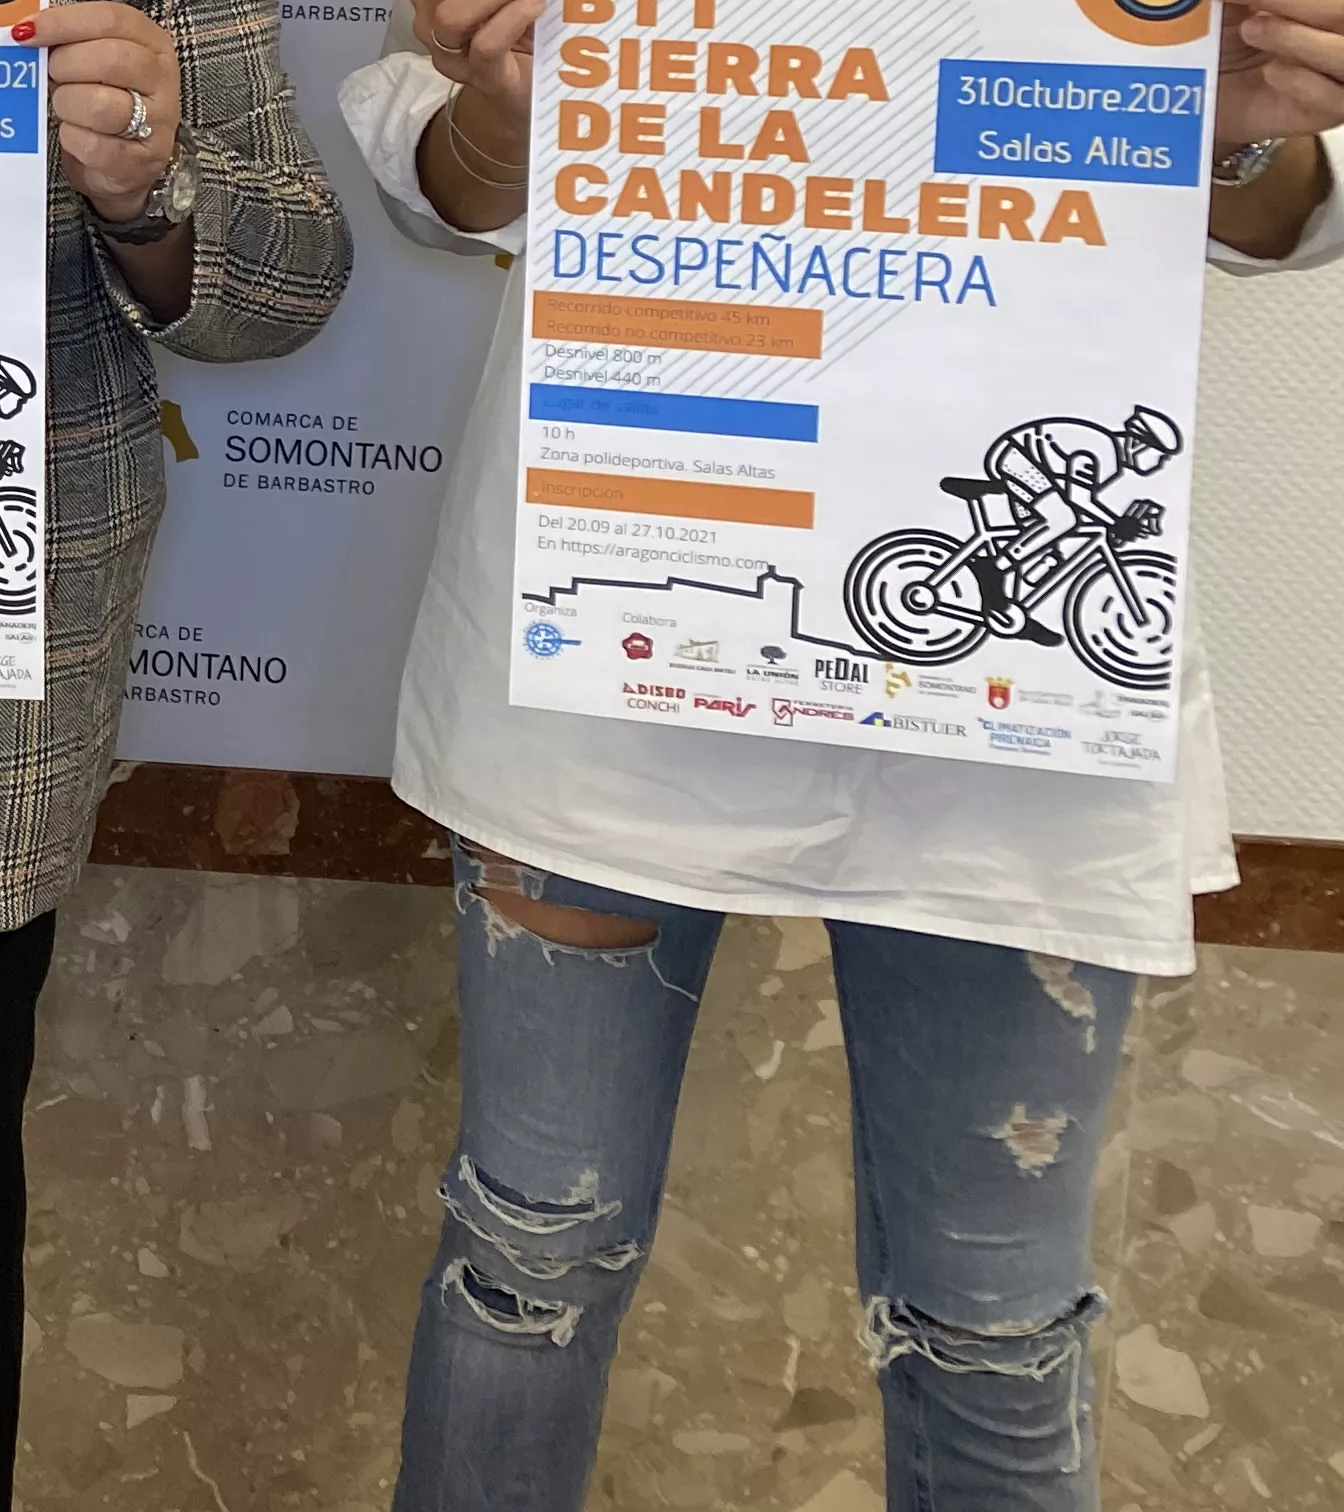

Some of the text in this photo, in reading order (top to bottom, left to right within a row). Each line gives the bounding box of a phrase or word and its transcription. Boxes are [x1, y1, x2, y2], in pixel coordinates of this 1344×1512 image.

[560, 37, 887, 101] SIERRA
[559, 101, 807, 162] DE LA
[979, 131, 1171, 168] Salas Altas
[555, 164, 1104, 245] CANDELERA
[553, 229, 995, 306] DESPEÑACERA
[228, 411, 357, 431] COMARCA DE
[225, 436, 442, 472] SOMONTANO
[224, 473, 374, 495] DE BARBASTRO
